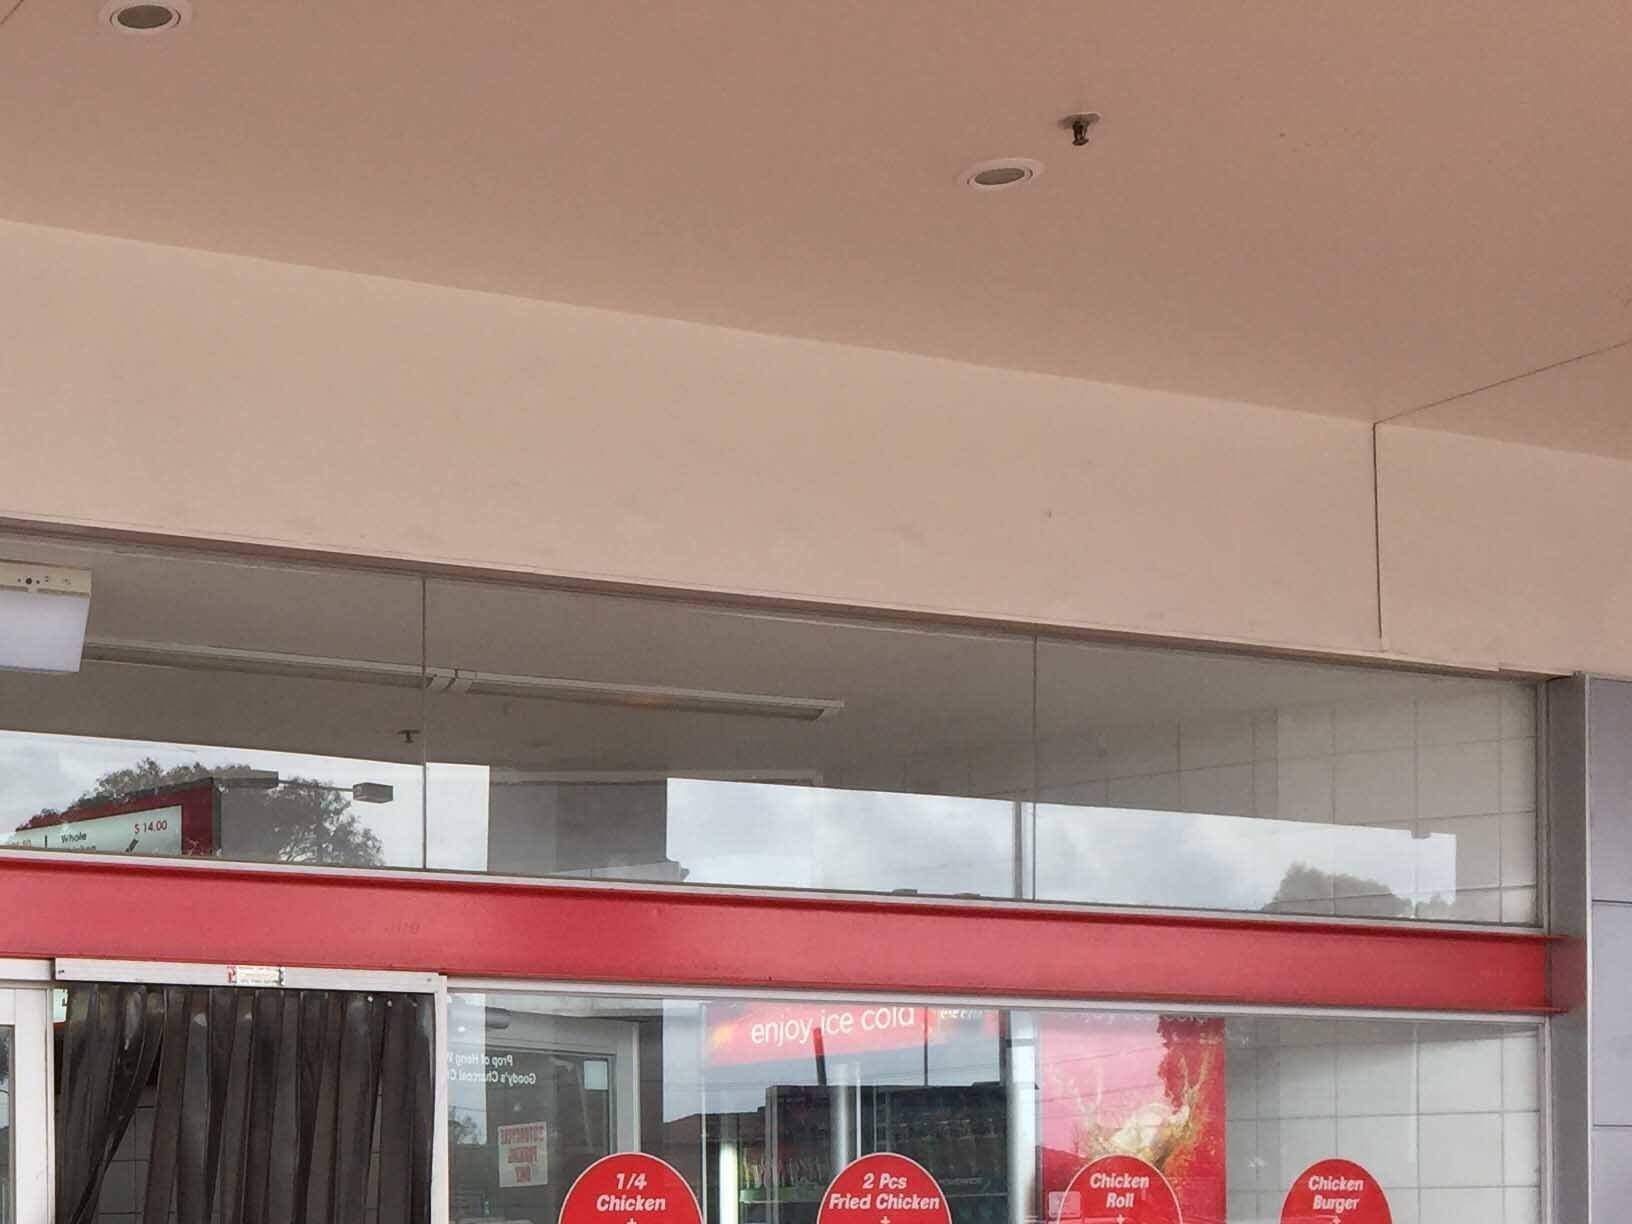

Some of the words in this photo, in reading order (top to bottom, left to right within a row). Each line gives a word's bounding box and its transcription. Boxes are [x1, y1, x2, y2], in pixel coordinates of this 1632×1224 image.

[143, 820, 168, 833] 14.00
[60, 831, 87, 844] Whole
[751, 1017, 814, 1046] enjoy
[820, 1009, 853, 1035] ice
[861, 1007, 915, 1031] cold
[616, 1173, 647, 1190] 1/4
[862, 1173, 874, 1189] 2
[879, 1173, 907, 1190] Pcs
[1090, 1173, 1149, 1189] Chicken
[1308, 1176, 1364, 1192] Chicken
[596, 1194, 666, 1212] Chicken
[829, 1193, 871, 1210] Fried
[876, 1193, 940, 1210] Chicken
[1106, 1192, 1134, 1208] Roll
[1312, 1195, 1360, 1214] Burger
